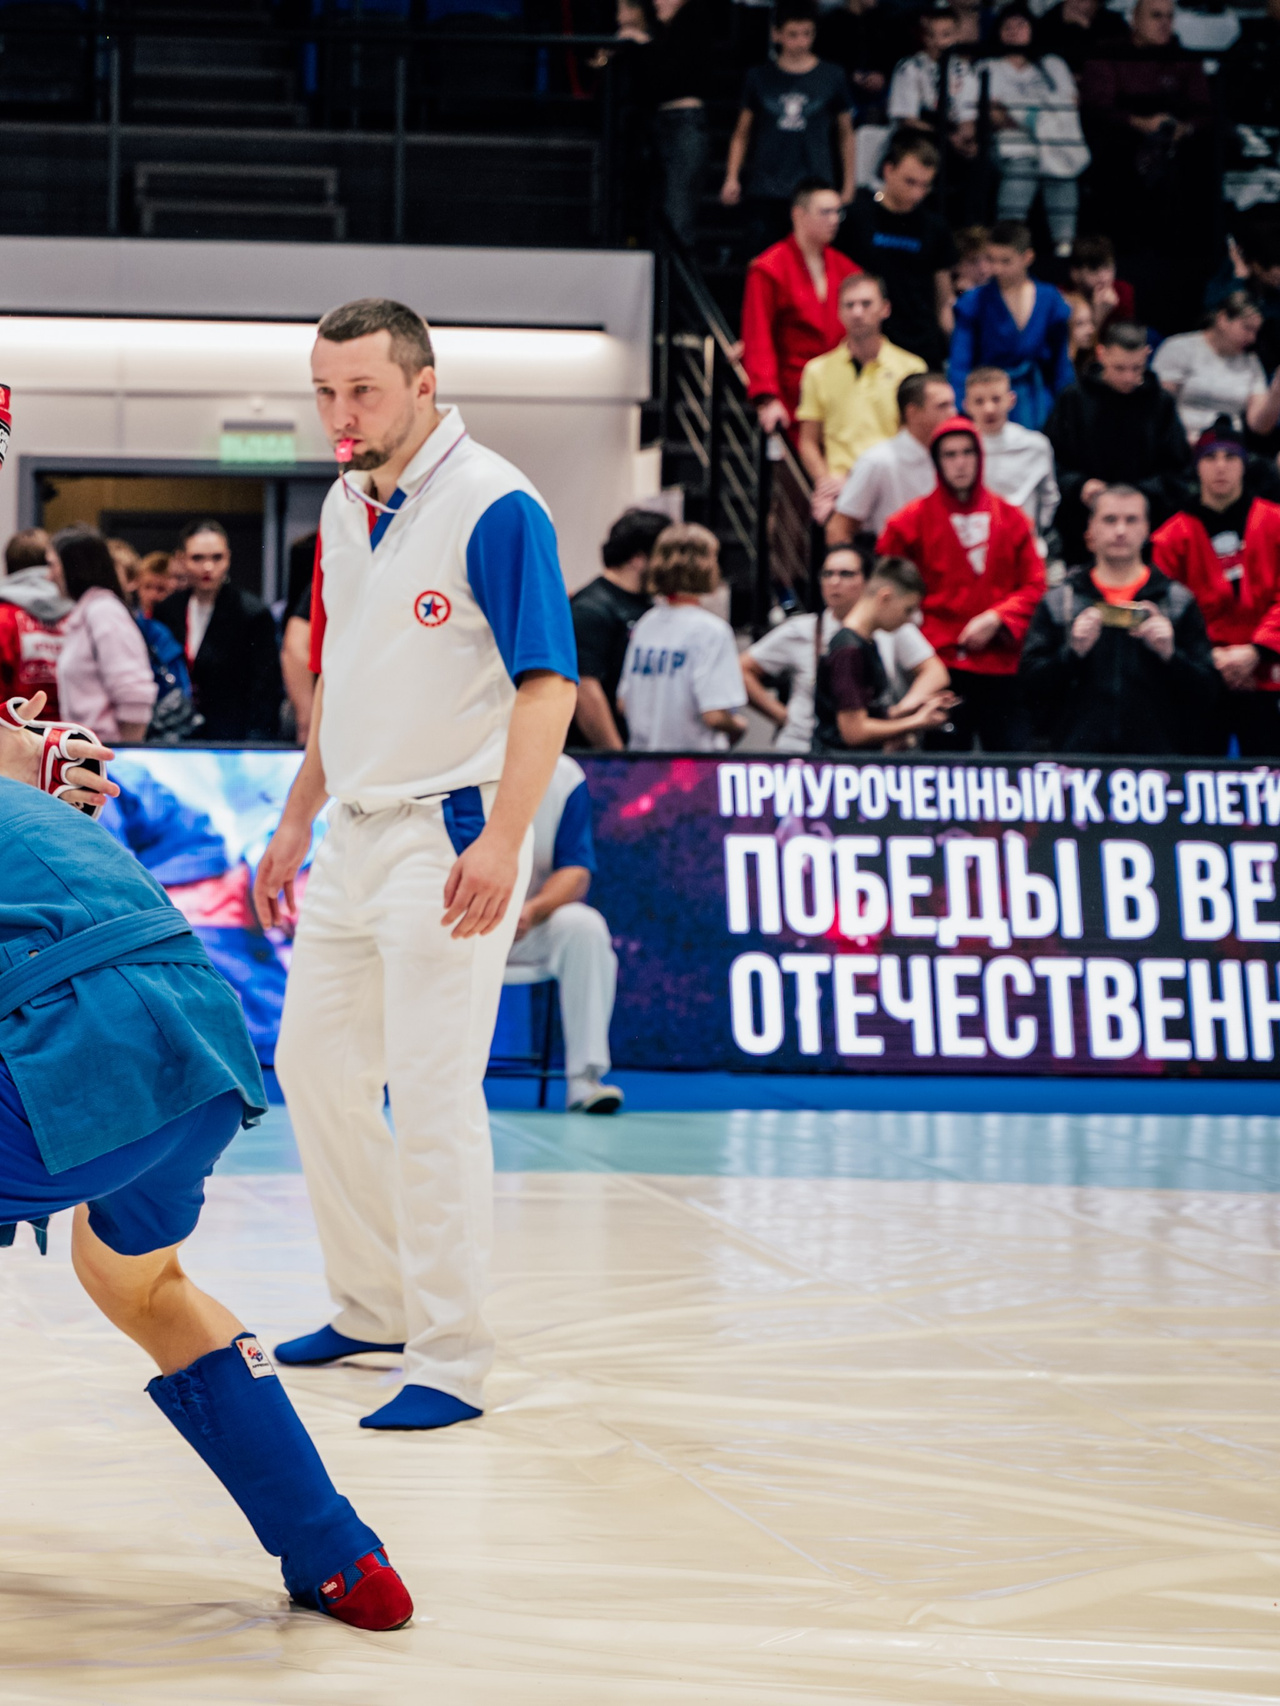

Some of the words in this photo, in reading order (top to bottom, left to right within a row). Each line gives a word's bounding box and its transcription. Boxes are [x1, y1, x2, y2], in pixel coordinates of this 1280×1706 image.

[718, 762, 1066, 822] ПРИУРОЧЕННЫЙ
[1068, 770, 1105, 823] К
[724, 832, 1083, 947] ПОБЕДЫ
[1100, 838, 1161, 941] В
[1174, 840, 1280, 943] ВЕ
[729, 952, 1280, 1062] ОТЕЧЕСТВЕНН
